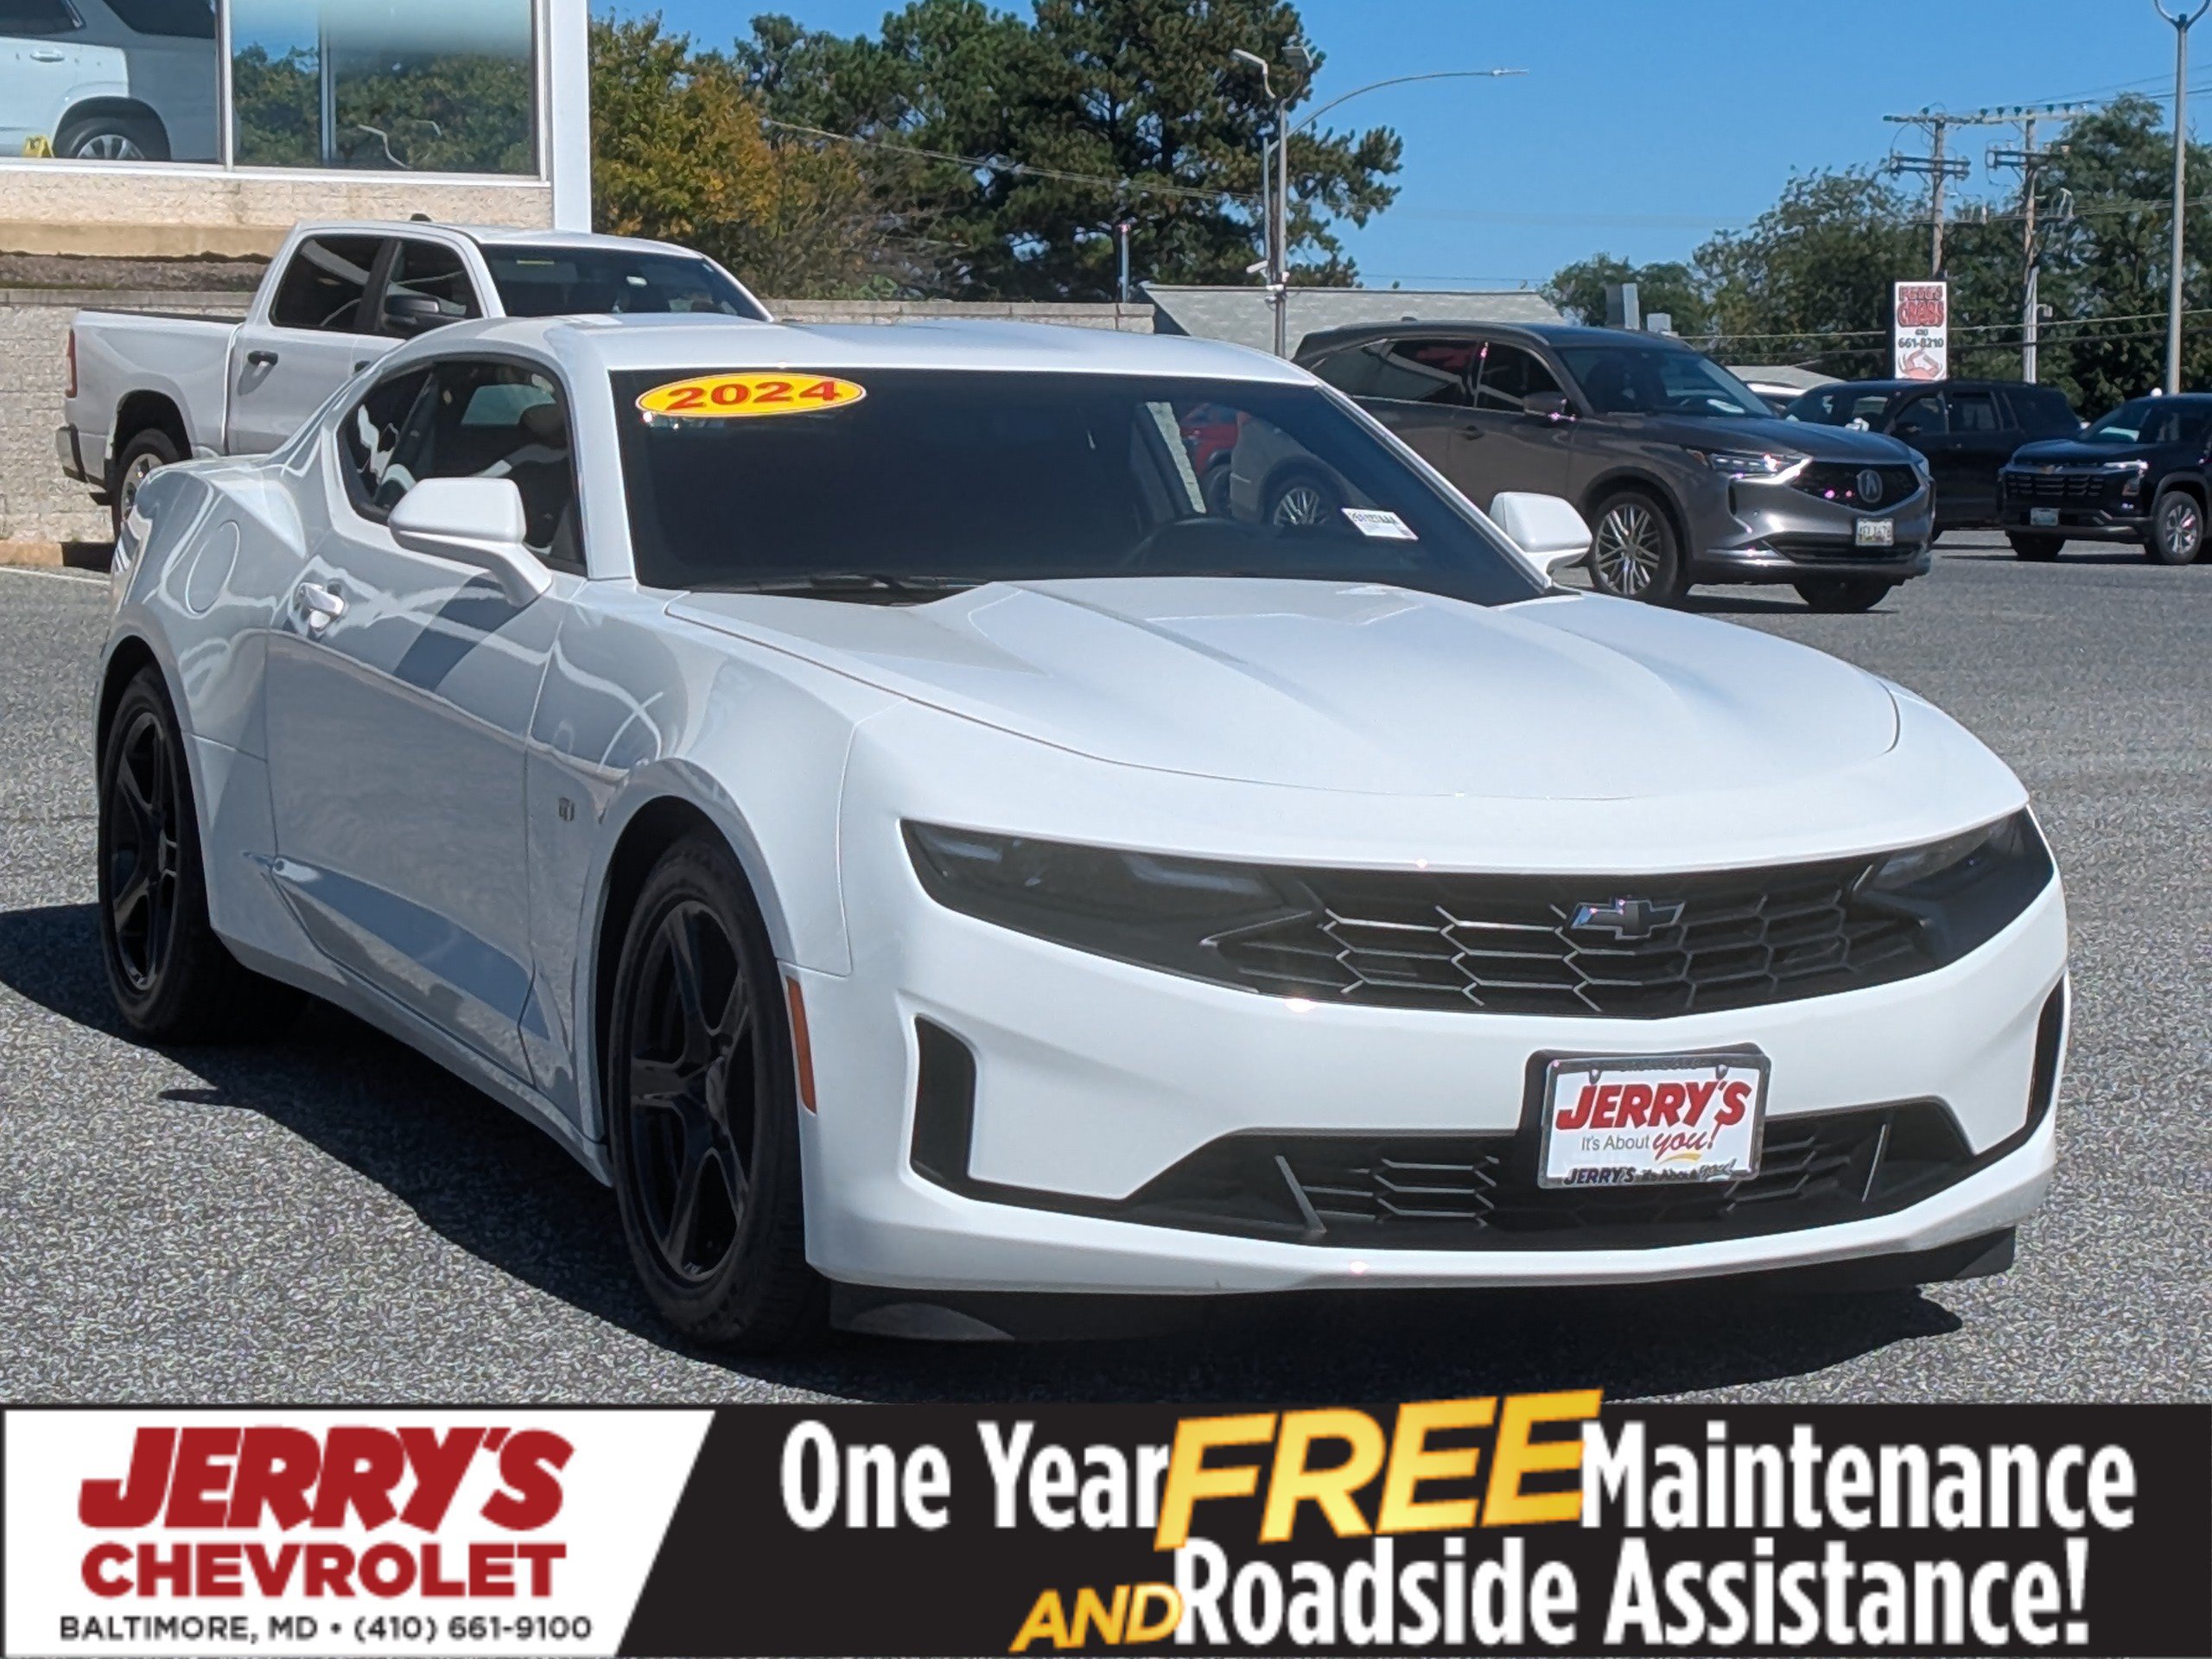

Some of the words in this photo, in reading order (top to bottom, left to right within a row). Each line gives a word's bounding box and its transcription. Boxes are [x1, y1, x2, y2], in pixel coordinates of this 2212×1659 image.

[665, 381, 842, 410] 2024
[1555, 1081, 1752, 1130] JERRY'S
[1581, 1135, 1599, 1151] It's
[1603, 1135, 1649, 1151] About
[1652, 1123, 1720, 1161] you!
[1564, 1166, 1637, 1185] JERRY'S
